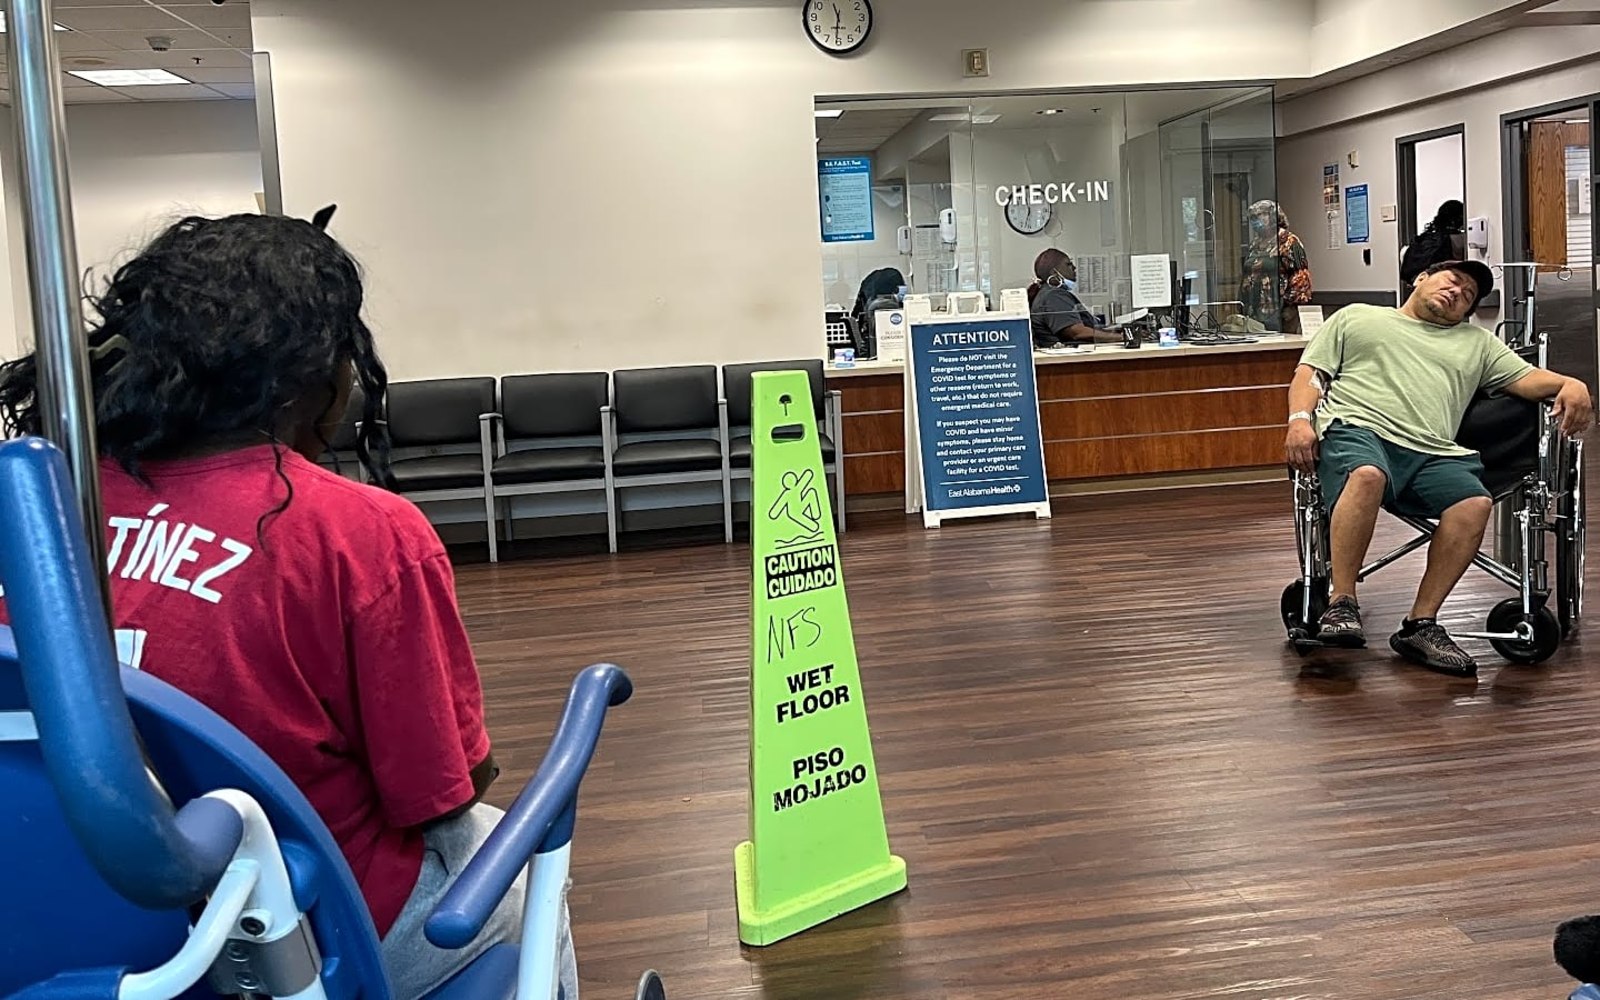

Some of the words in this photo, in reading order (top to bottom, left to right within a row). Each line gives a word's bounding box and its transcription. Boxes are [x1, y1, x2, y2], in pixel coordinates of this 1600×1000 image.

[814, 2, 823, 10] 10
[854, 2, 860, 10] 2
[811, 13, 817, 21] 9
[859, 13, 865, 21] 3
[814, 25, 821, 33] 8
[854, 25, 861, 33] 4
[824, 34, 830, 43] 7
[835, 38, 842, 46] 6
[847, 34, 853, 42] 5
[995, 181, 1109, 207] CHECK-IN
[933, 330, 1009, 345] ATTENTION
[941, 403, 970, 411] emergent
[937, 439, 971, 447] symptoms,
[943, 458, 968, 466] provider
[108, 503, 253, 604] TÍNEZ
[768, 547, 833, 575] CAUTION
[768, 568, 835, 598] CUIDADO
[768, 607, 821, 663] NFS
[787, 664, 834, 694] WET
[776, 685, 850, 723] FLOOR
[793, 747, 844, 779] PISO
[774, 764, 866, 811] MOJADO
